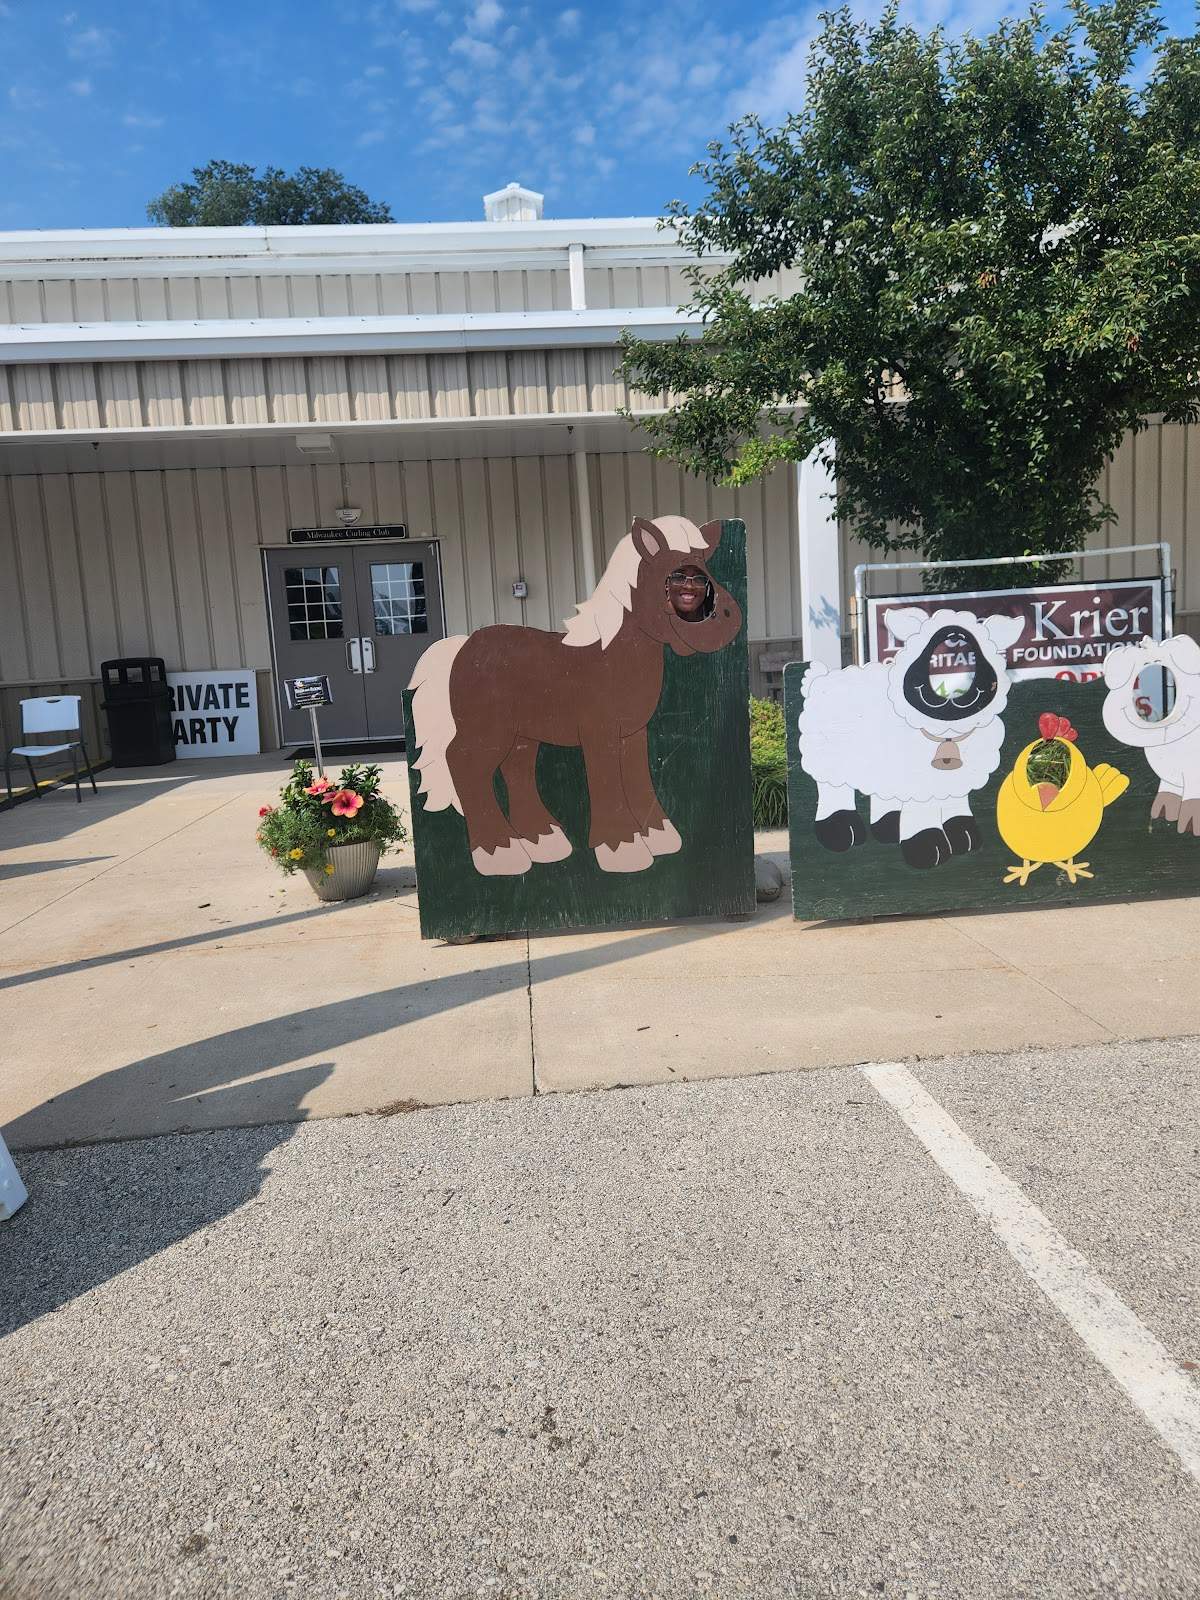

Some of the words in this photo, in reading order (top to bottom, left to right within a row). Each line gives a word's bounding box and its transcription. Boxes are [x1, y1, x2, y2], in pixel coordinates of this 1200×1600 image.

[345, 529, 371, 538] Curling
[373, 528, 390, 536] Club
[1030, 596, 1149, 642] Krier
[1013, 641, 1139, 663] FOUNDATI
[167, 682, 250, 712] RIVATE
[174, 716, 239, 745] ARTY
